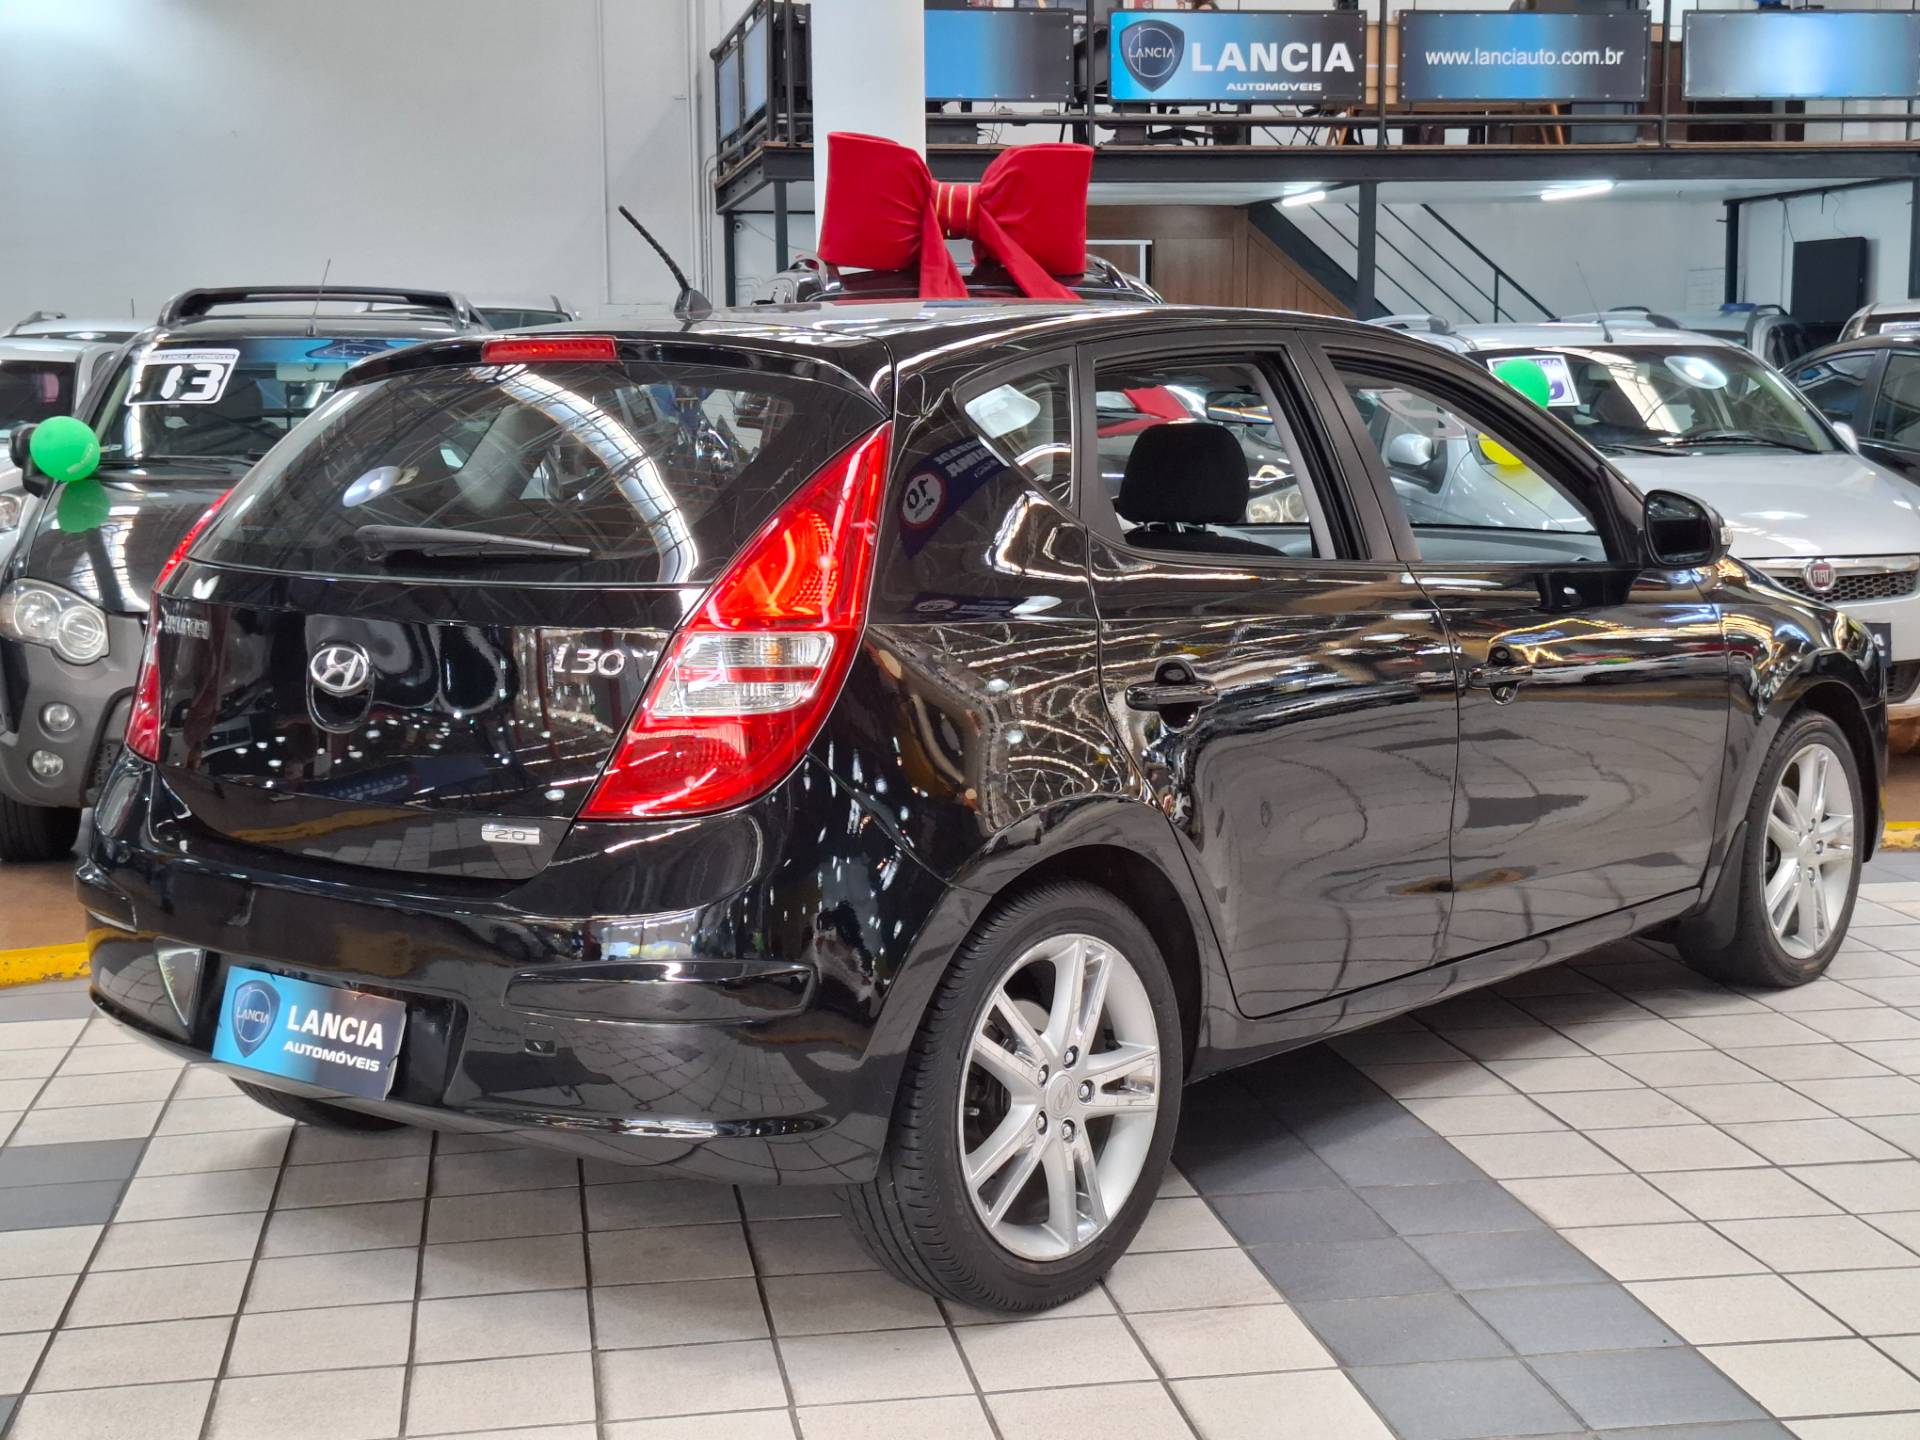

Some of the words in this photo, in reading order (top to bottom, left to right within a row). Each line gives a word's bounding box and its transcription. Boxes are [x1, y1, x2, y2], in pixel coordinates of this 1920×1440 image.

[1128, 47, 1176, 59] LANCIA
[1191, 42, 1355, 73] LANCIA
[1425, 47, 1624, 66] www.lanciauto.com.br
[1226, 82, 1322, 92] AUTOMÓVEIS
[160, 364, 225, 401] 13
[236, 1007, 270, 1024] LANCIA
[287, 1005, 383, 1050] LANCIA
[283, 1041, 381, 1073] AUTOMÓVEIS
